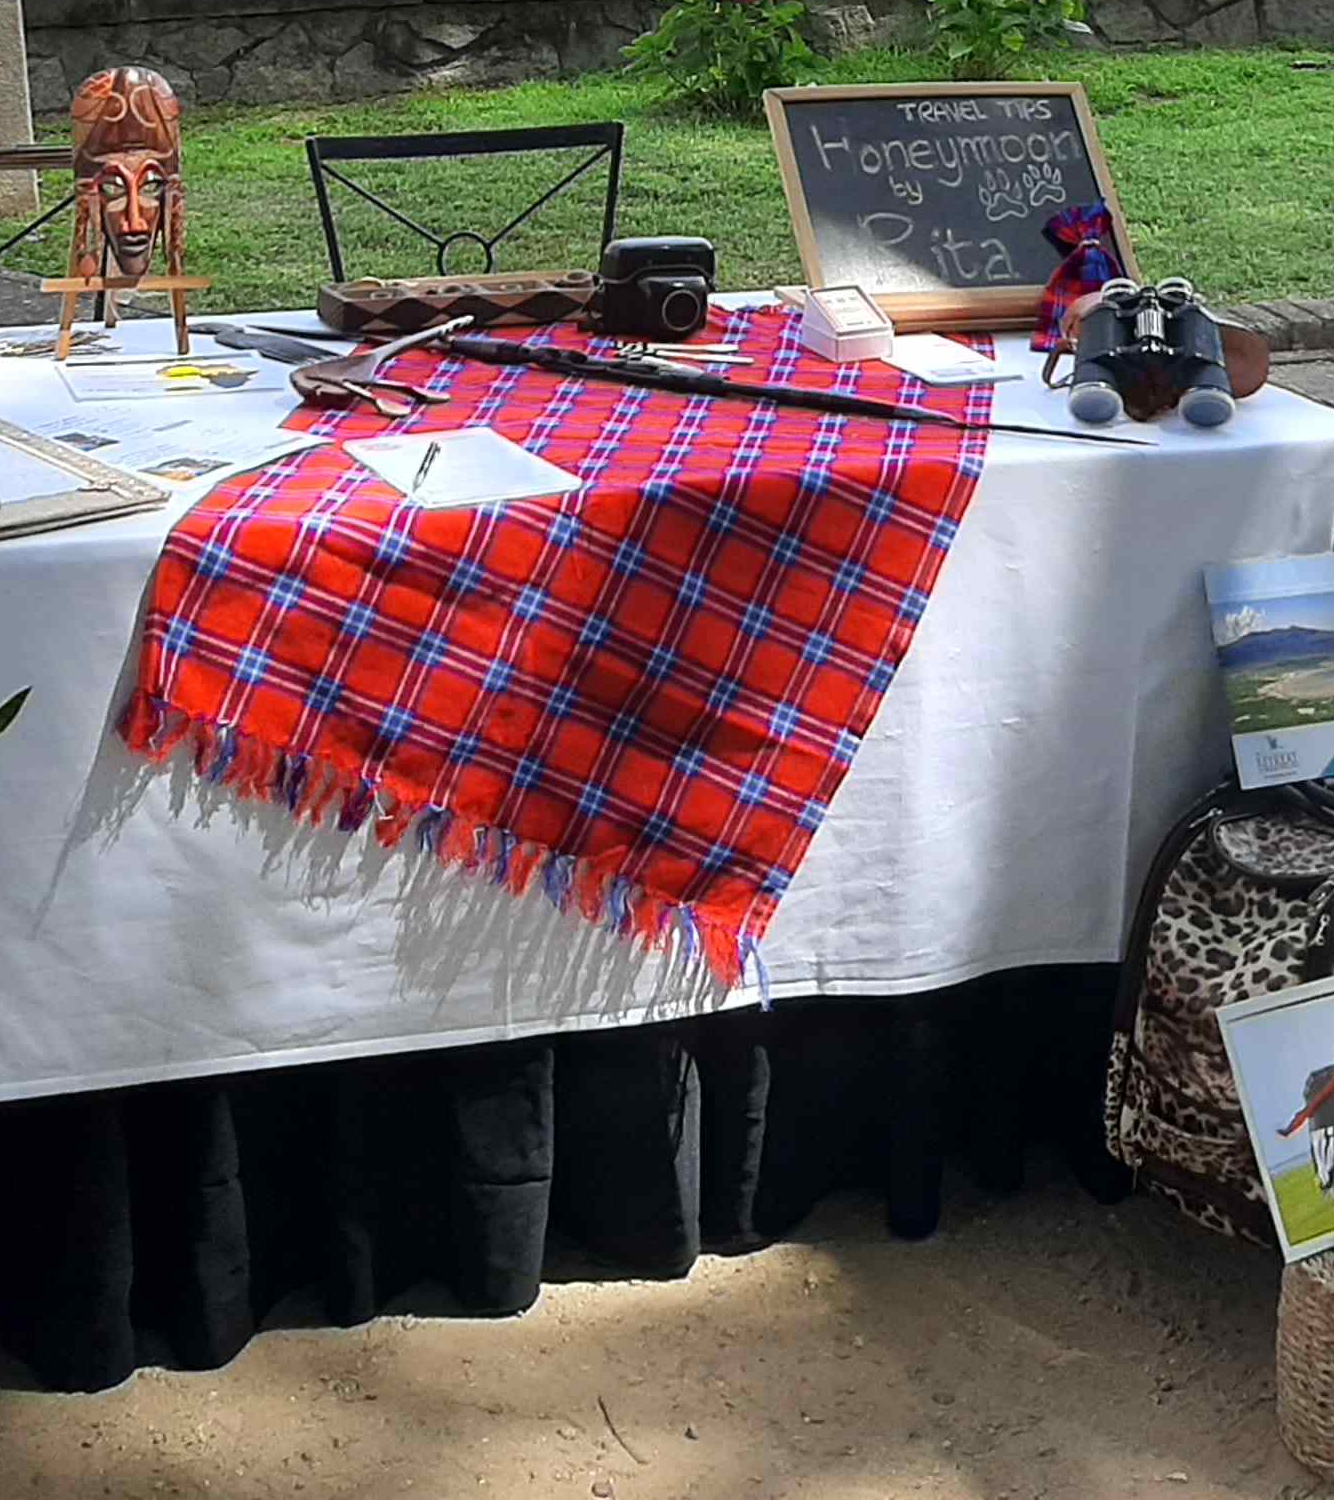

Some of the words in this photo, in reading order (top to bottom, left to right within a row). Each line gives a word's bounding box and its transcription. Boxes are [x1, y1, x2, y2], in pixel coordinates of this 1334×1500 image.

[897, 100, 988, 122] TRAVEL
[998, 99, 1052, 120] TIPS
[810, 125, 1082, 187] Honeymoon
[889, 175, 923, 205] by
